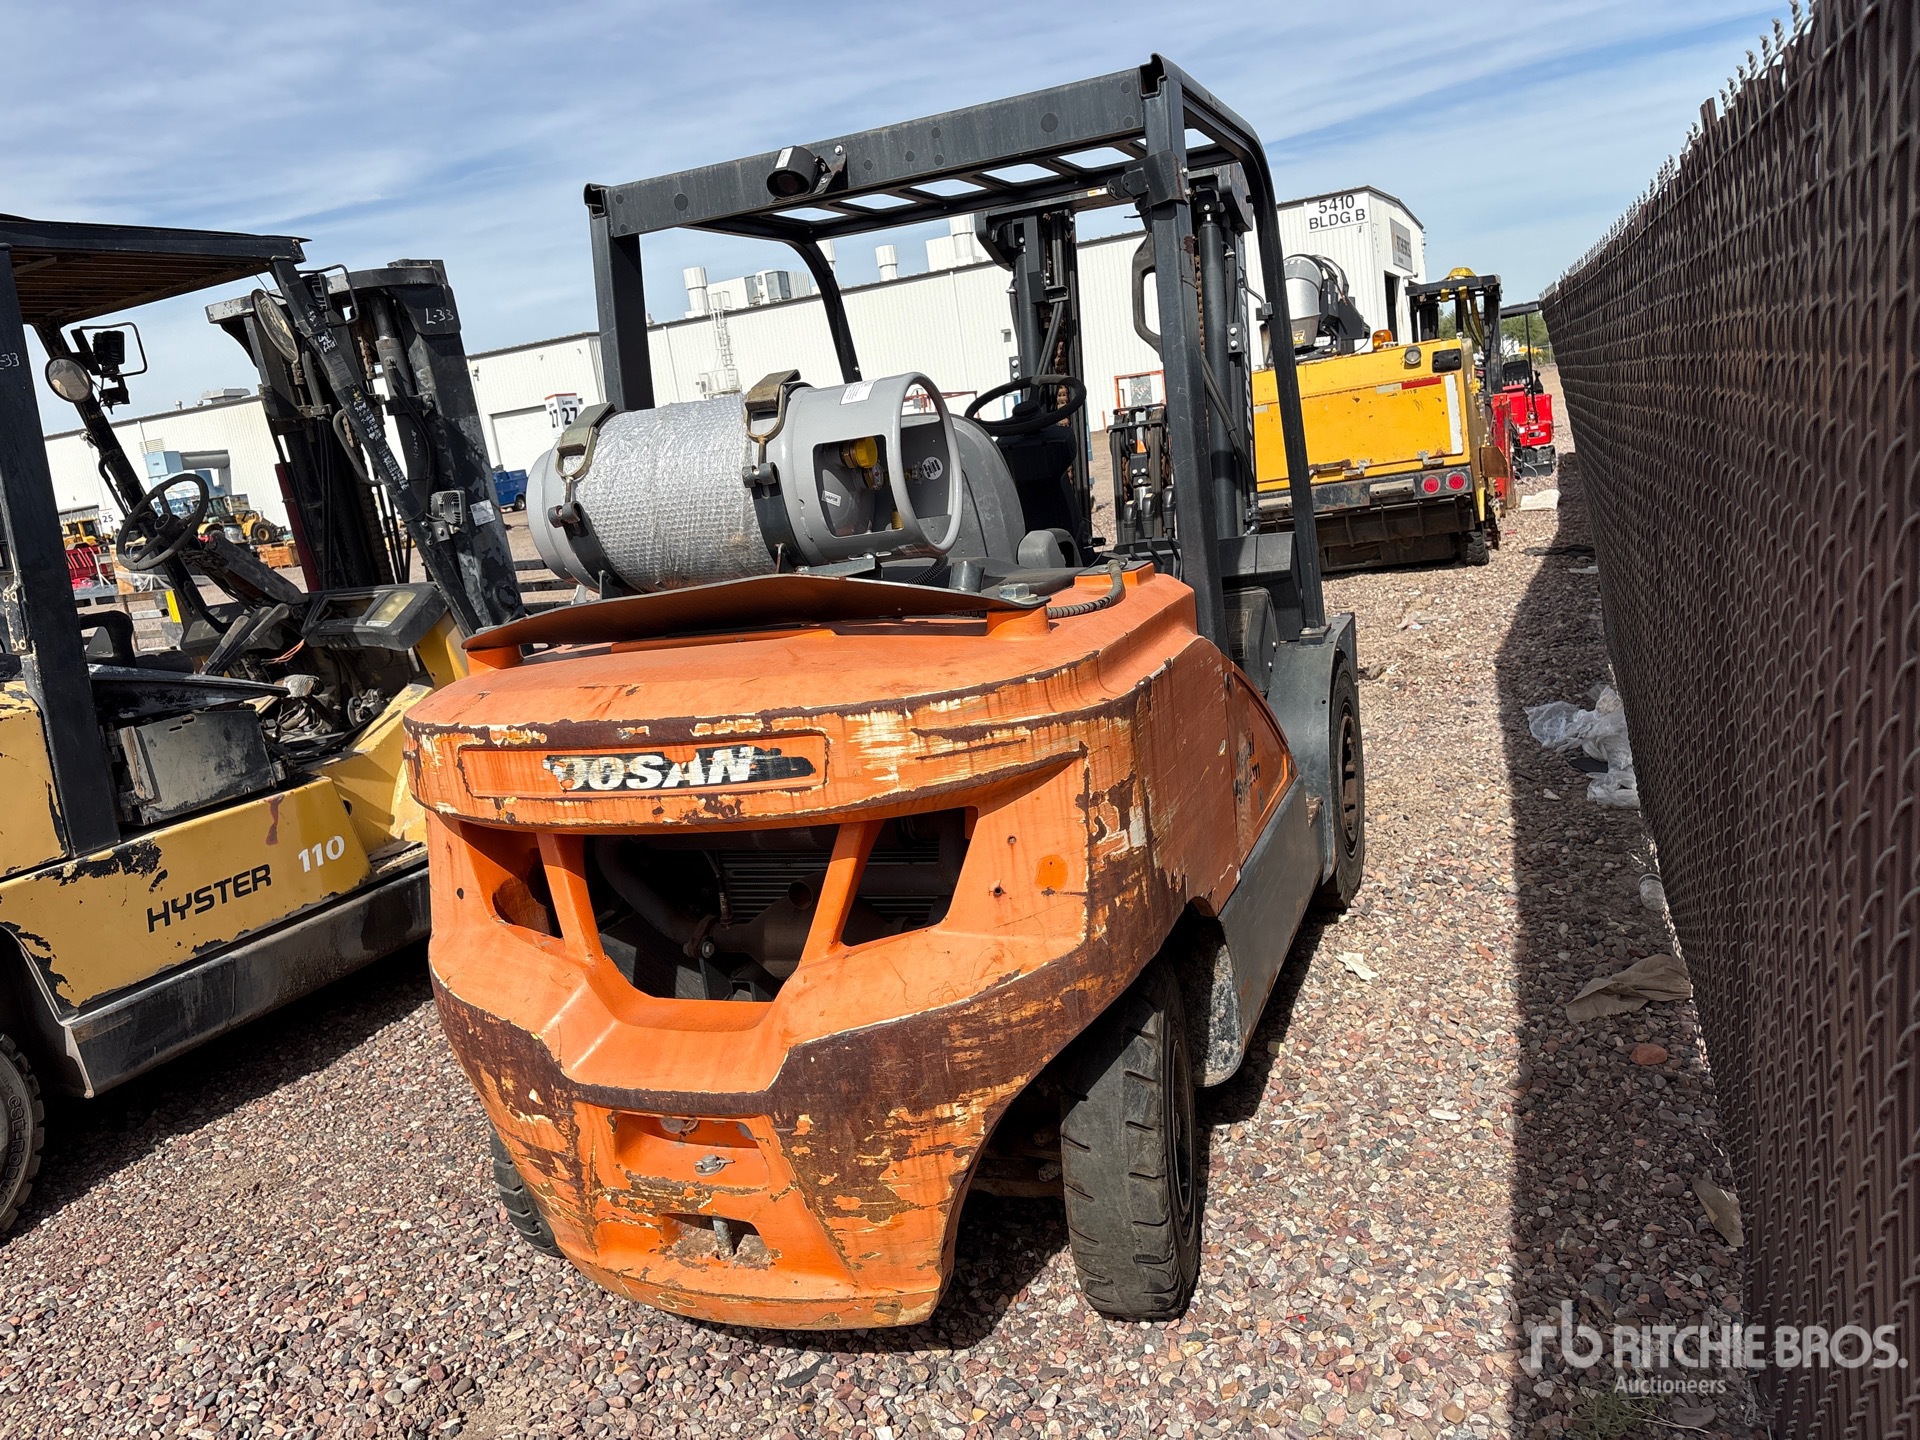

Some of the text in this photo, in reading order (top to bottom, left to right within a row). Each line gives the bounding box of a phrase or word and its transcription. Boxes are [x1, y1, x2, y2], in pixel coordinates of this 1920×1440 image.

[1318, 195, 1355, 214] 5410
[425, 307, 454, 325] L-33
[561, 407, 578, 425] 27
[102, 514, 114, 523] 25
[298, 835, 345, 873] 110
[146, 863, 272, 934] HYSTER
